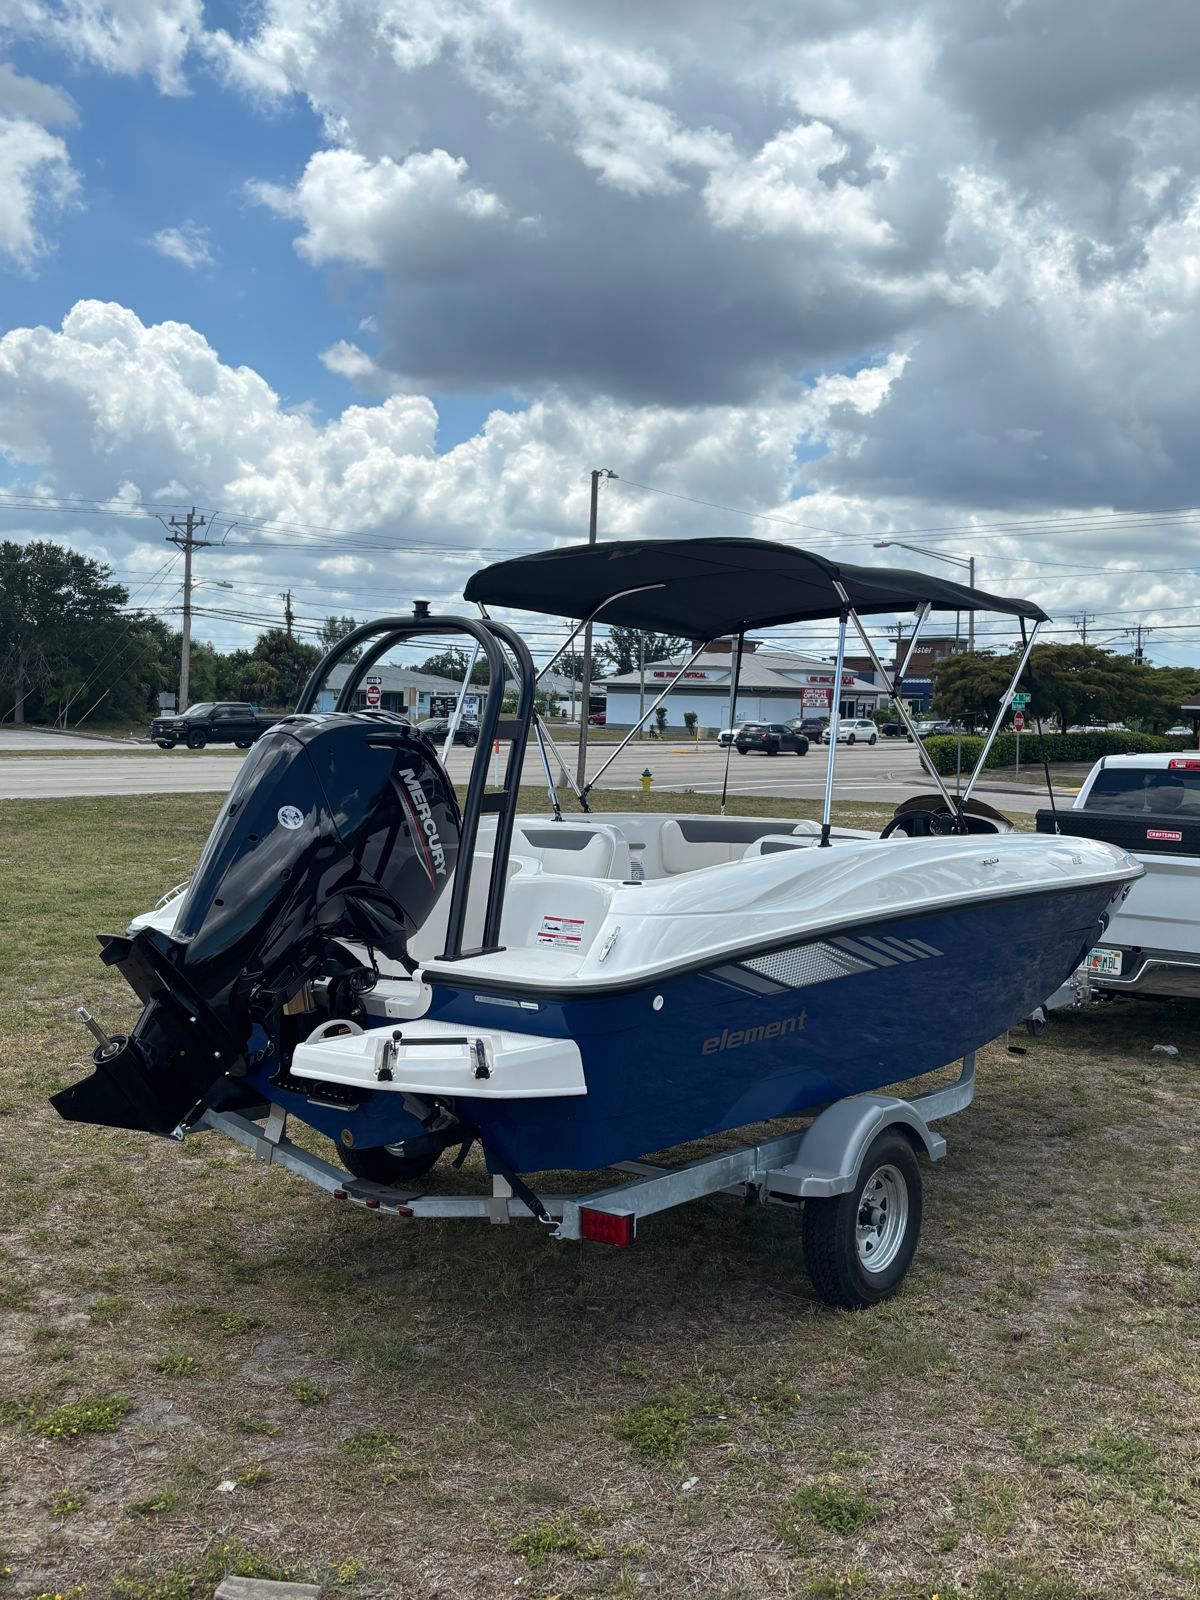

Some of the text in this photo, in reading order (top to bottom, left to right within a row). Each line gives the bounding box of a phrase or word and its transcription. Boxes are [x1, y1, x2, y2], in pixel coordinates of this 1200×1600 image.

[911, 646, 934, 654] ister
[684, 671, 706, 679] OPTICAL
[399, 768, 447, 875] MERCURY
[1149, 831, 1180, 839] CRAFTSMAN
[702, 1009, 808, 1055] element
